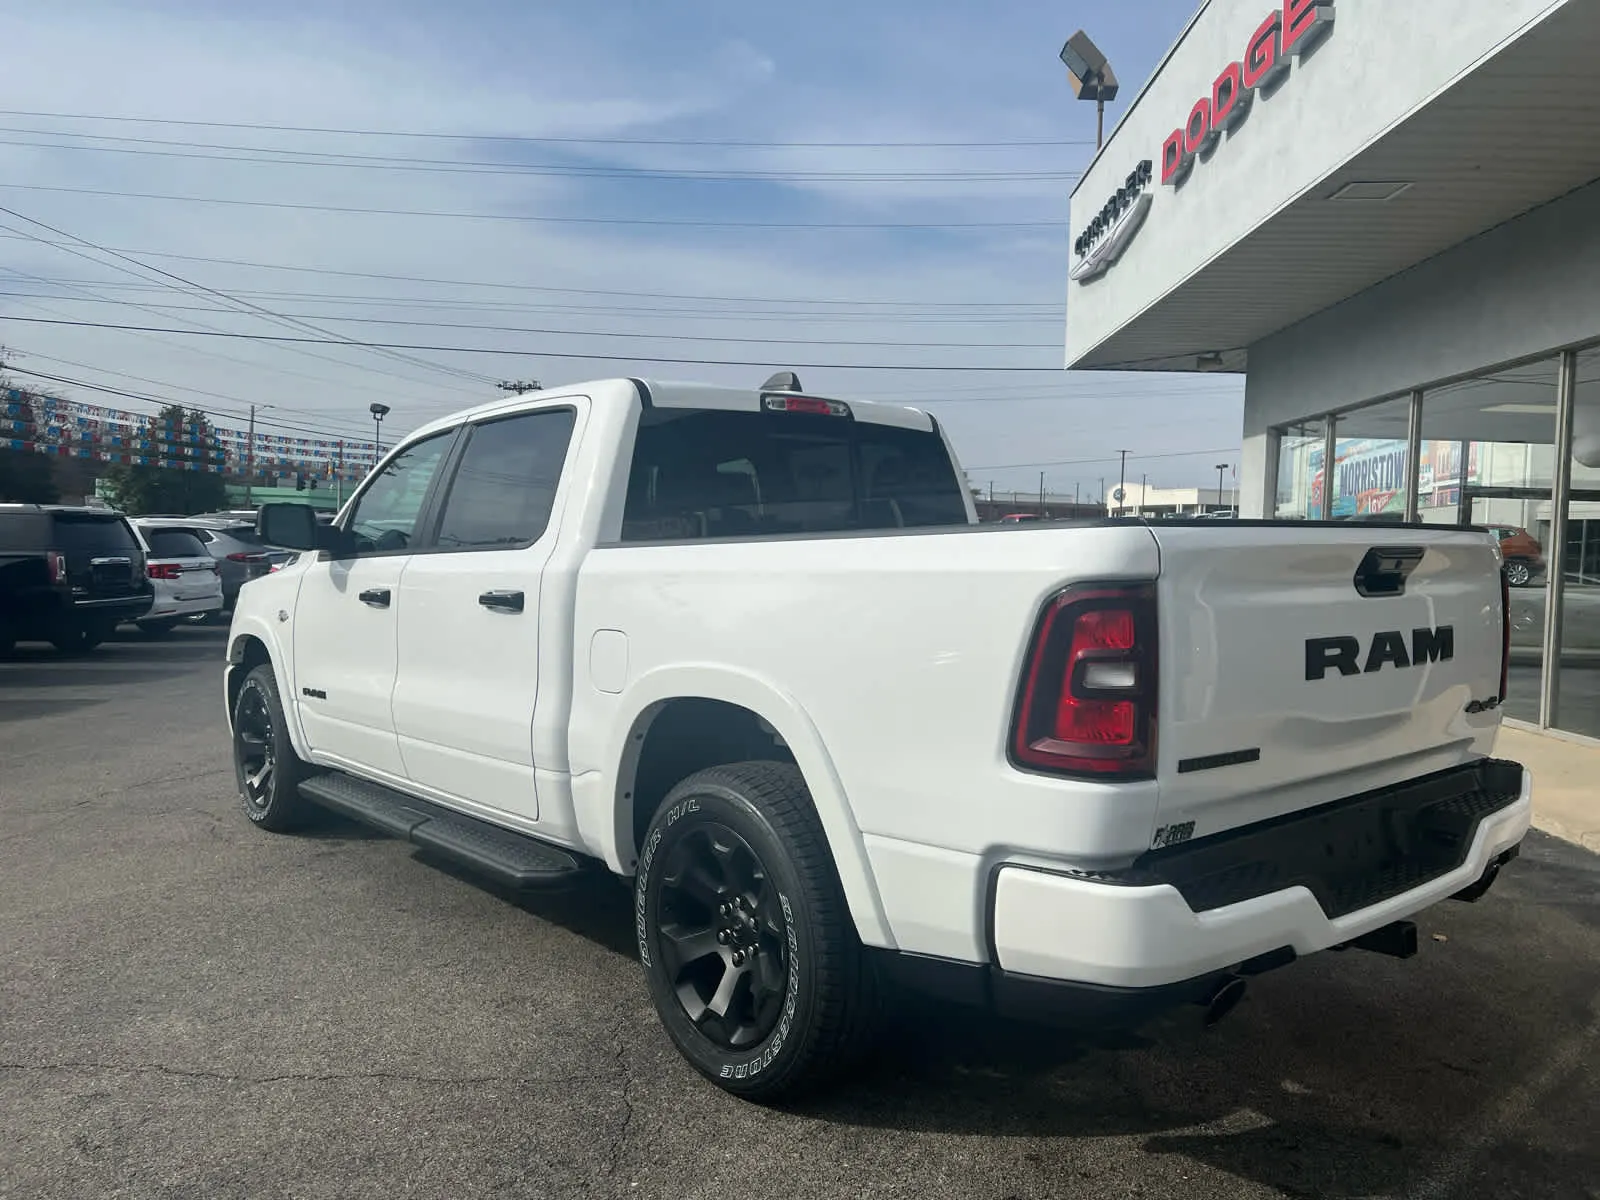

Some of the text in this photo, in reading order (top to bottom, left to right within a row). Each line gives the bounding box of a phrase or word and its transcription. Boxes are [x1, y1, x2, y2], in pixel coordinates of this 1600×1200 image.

[1161, 0, 1333, 187] DODGE
[1340, 449, 1408, 497] MORRISTOW
[1305, 625, 1454, 681] RAM
[634, 799, 700, 967] DUELER H/L
[720, 891, 799, 1079] BRIDGESTONE
